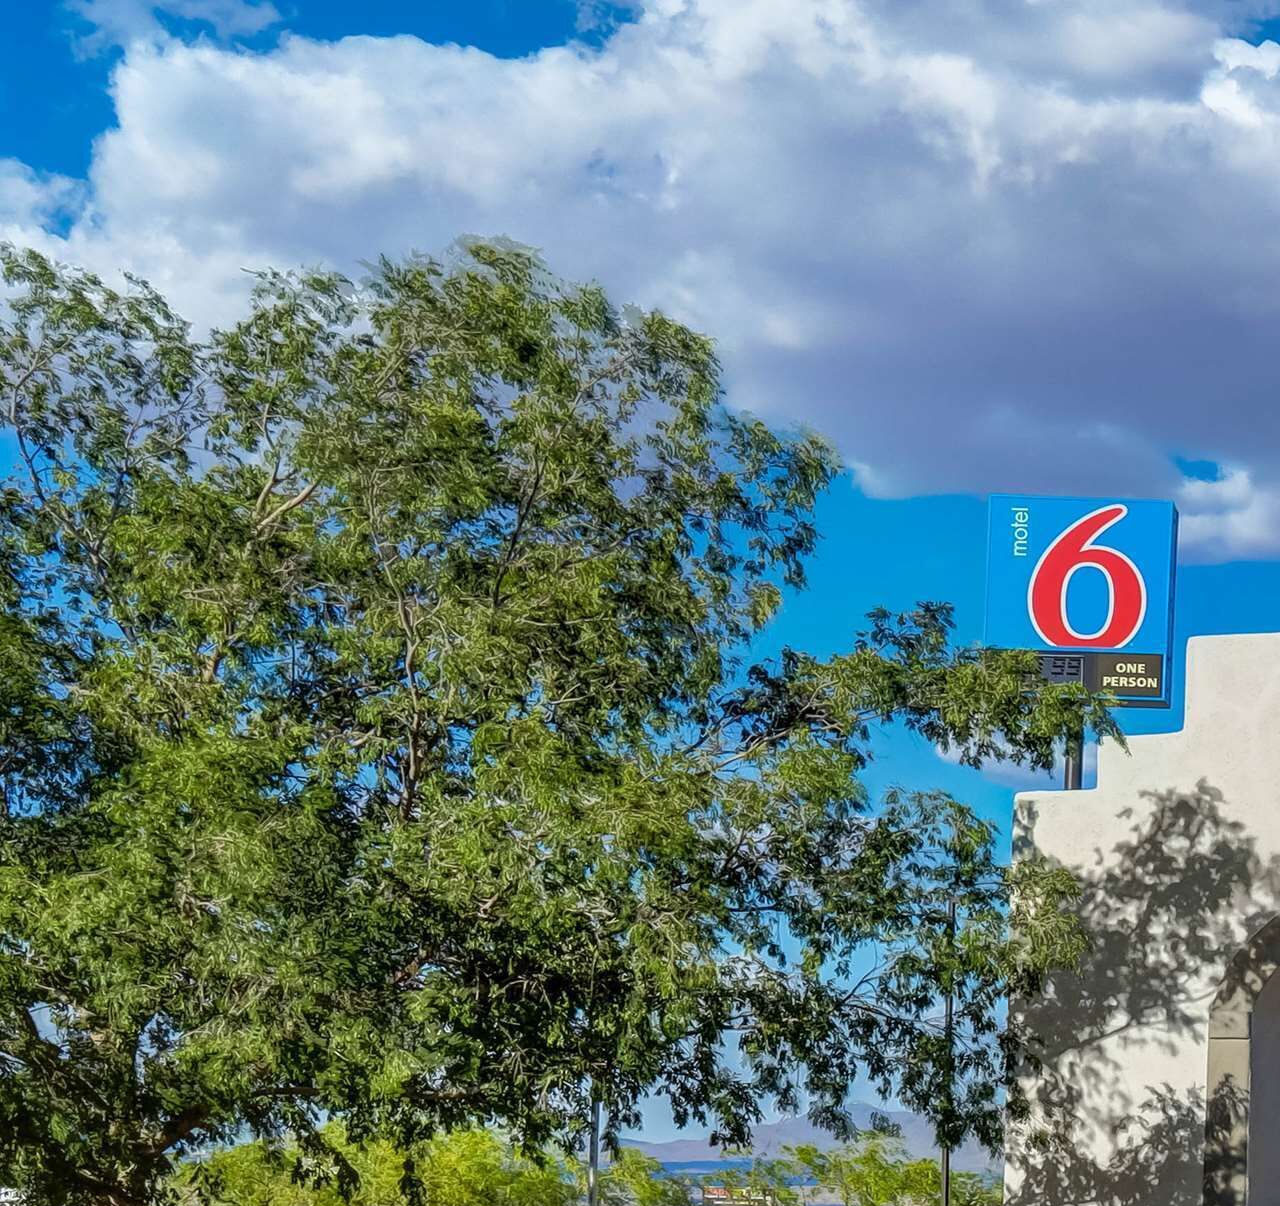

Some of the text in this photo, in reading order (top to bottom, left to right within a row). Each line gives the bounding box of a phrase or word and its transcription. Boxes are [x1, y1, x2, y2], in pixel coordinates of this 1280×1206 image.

[1011, 504, 1147, 649] motel 6
[1115, 663, 1146, 674] ONE
[1103, 676, 1158, 688] PERSON
